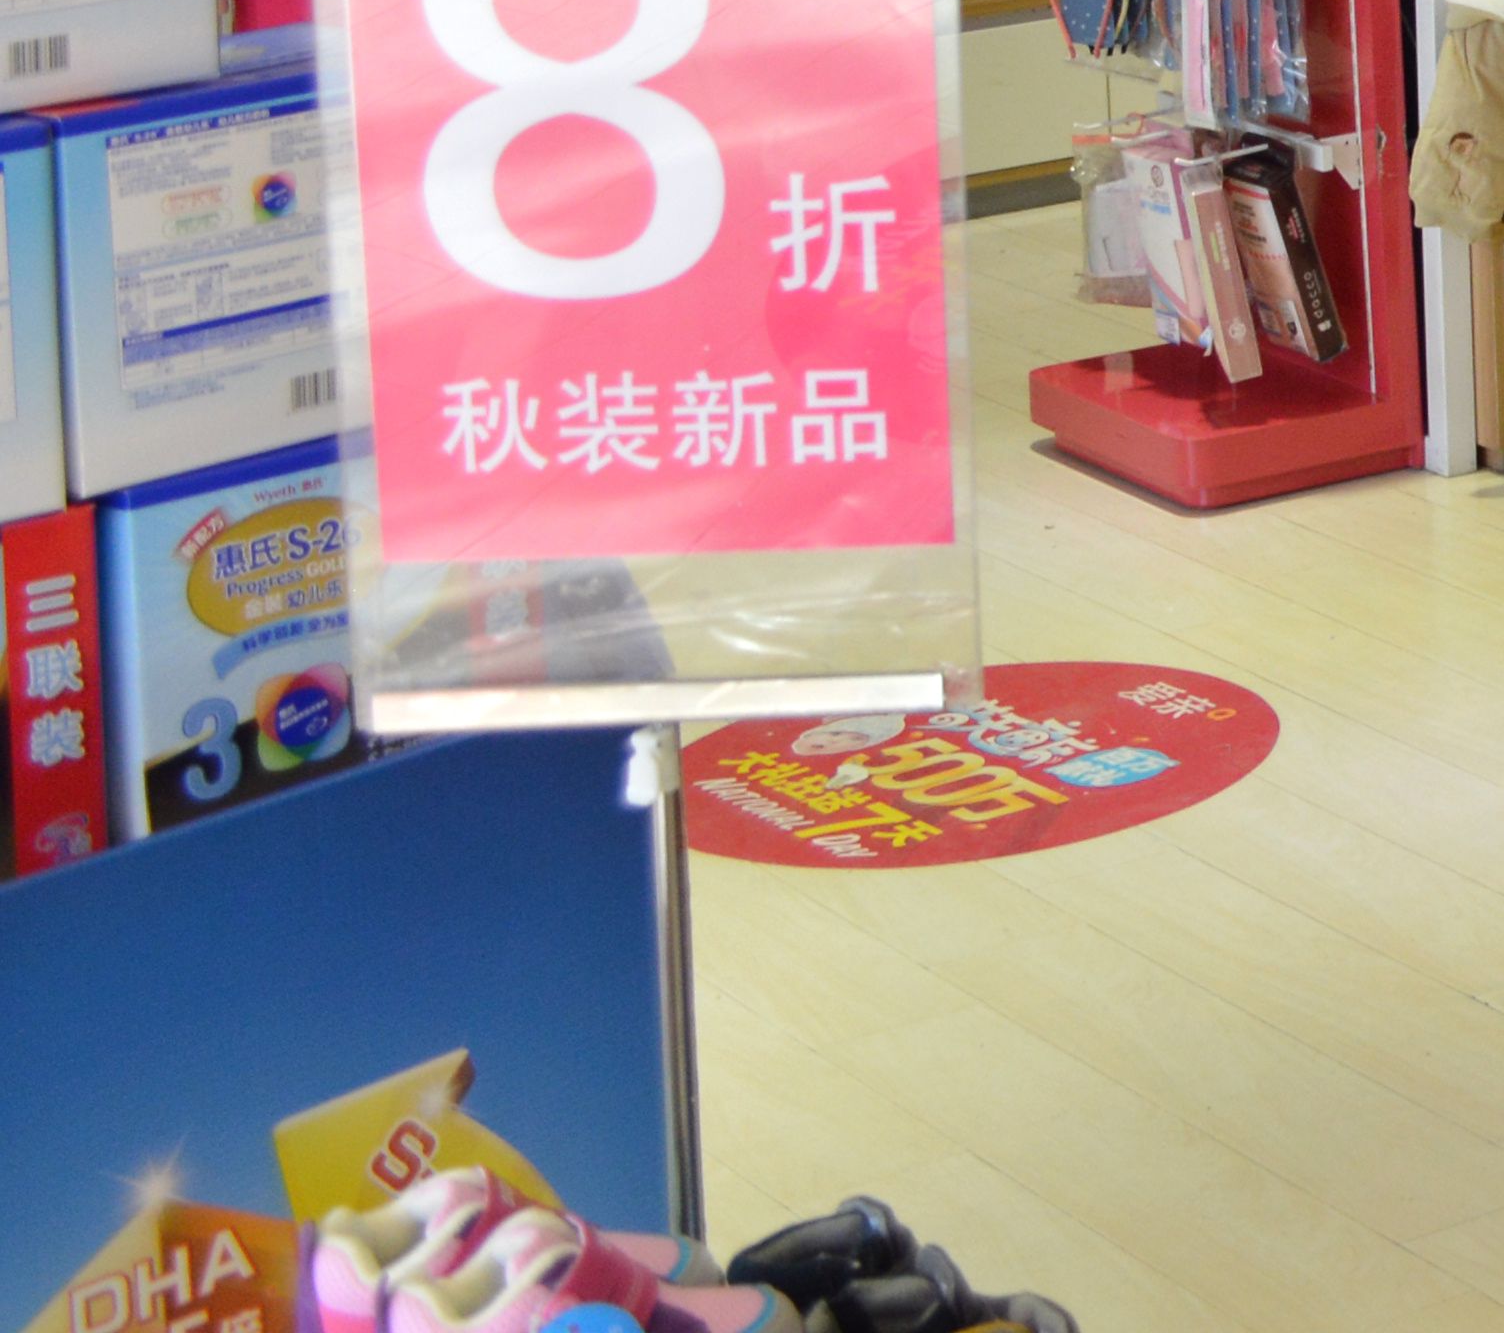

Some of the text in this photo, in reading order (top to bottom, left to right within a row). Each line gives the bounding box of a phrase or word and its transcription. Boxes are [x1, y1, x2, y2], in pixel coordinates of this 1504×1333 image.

[439, 367, 889, 477] 秋装新品
[253, 482, 296, 504] Wyeth
[213, 533, 282, 580] 惠氏
[225, 570, 304, 600] Progress
[24, 573, 87, 769] 三联装
[1117, 679, 1215, 722] 爱亲
[181, 696, 243, 804] 3
[693, 777, 815, 833] NATIONAL
[812, 831, 880, 859] DAY
[67, 1229, 257, 1333] DHA
